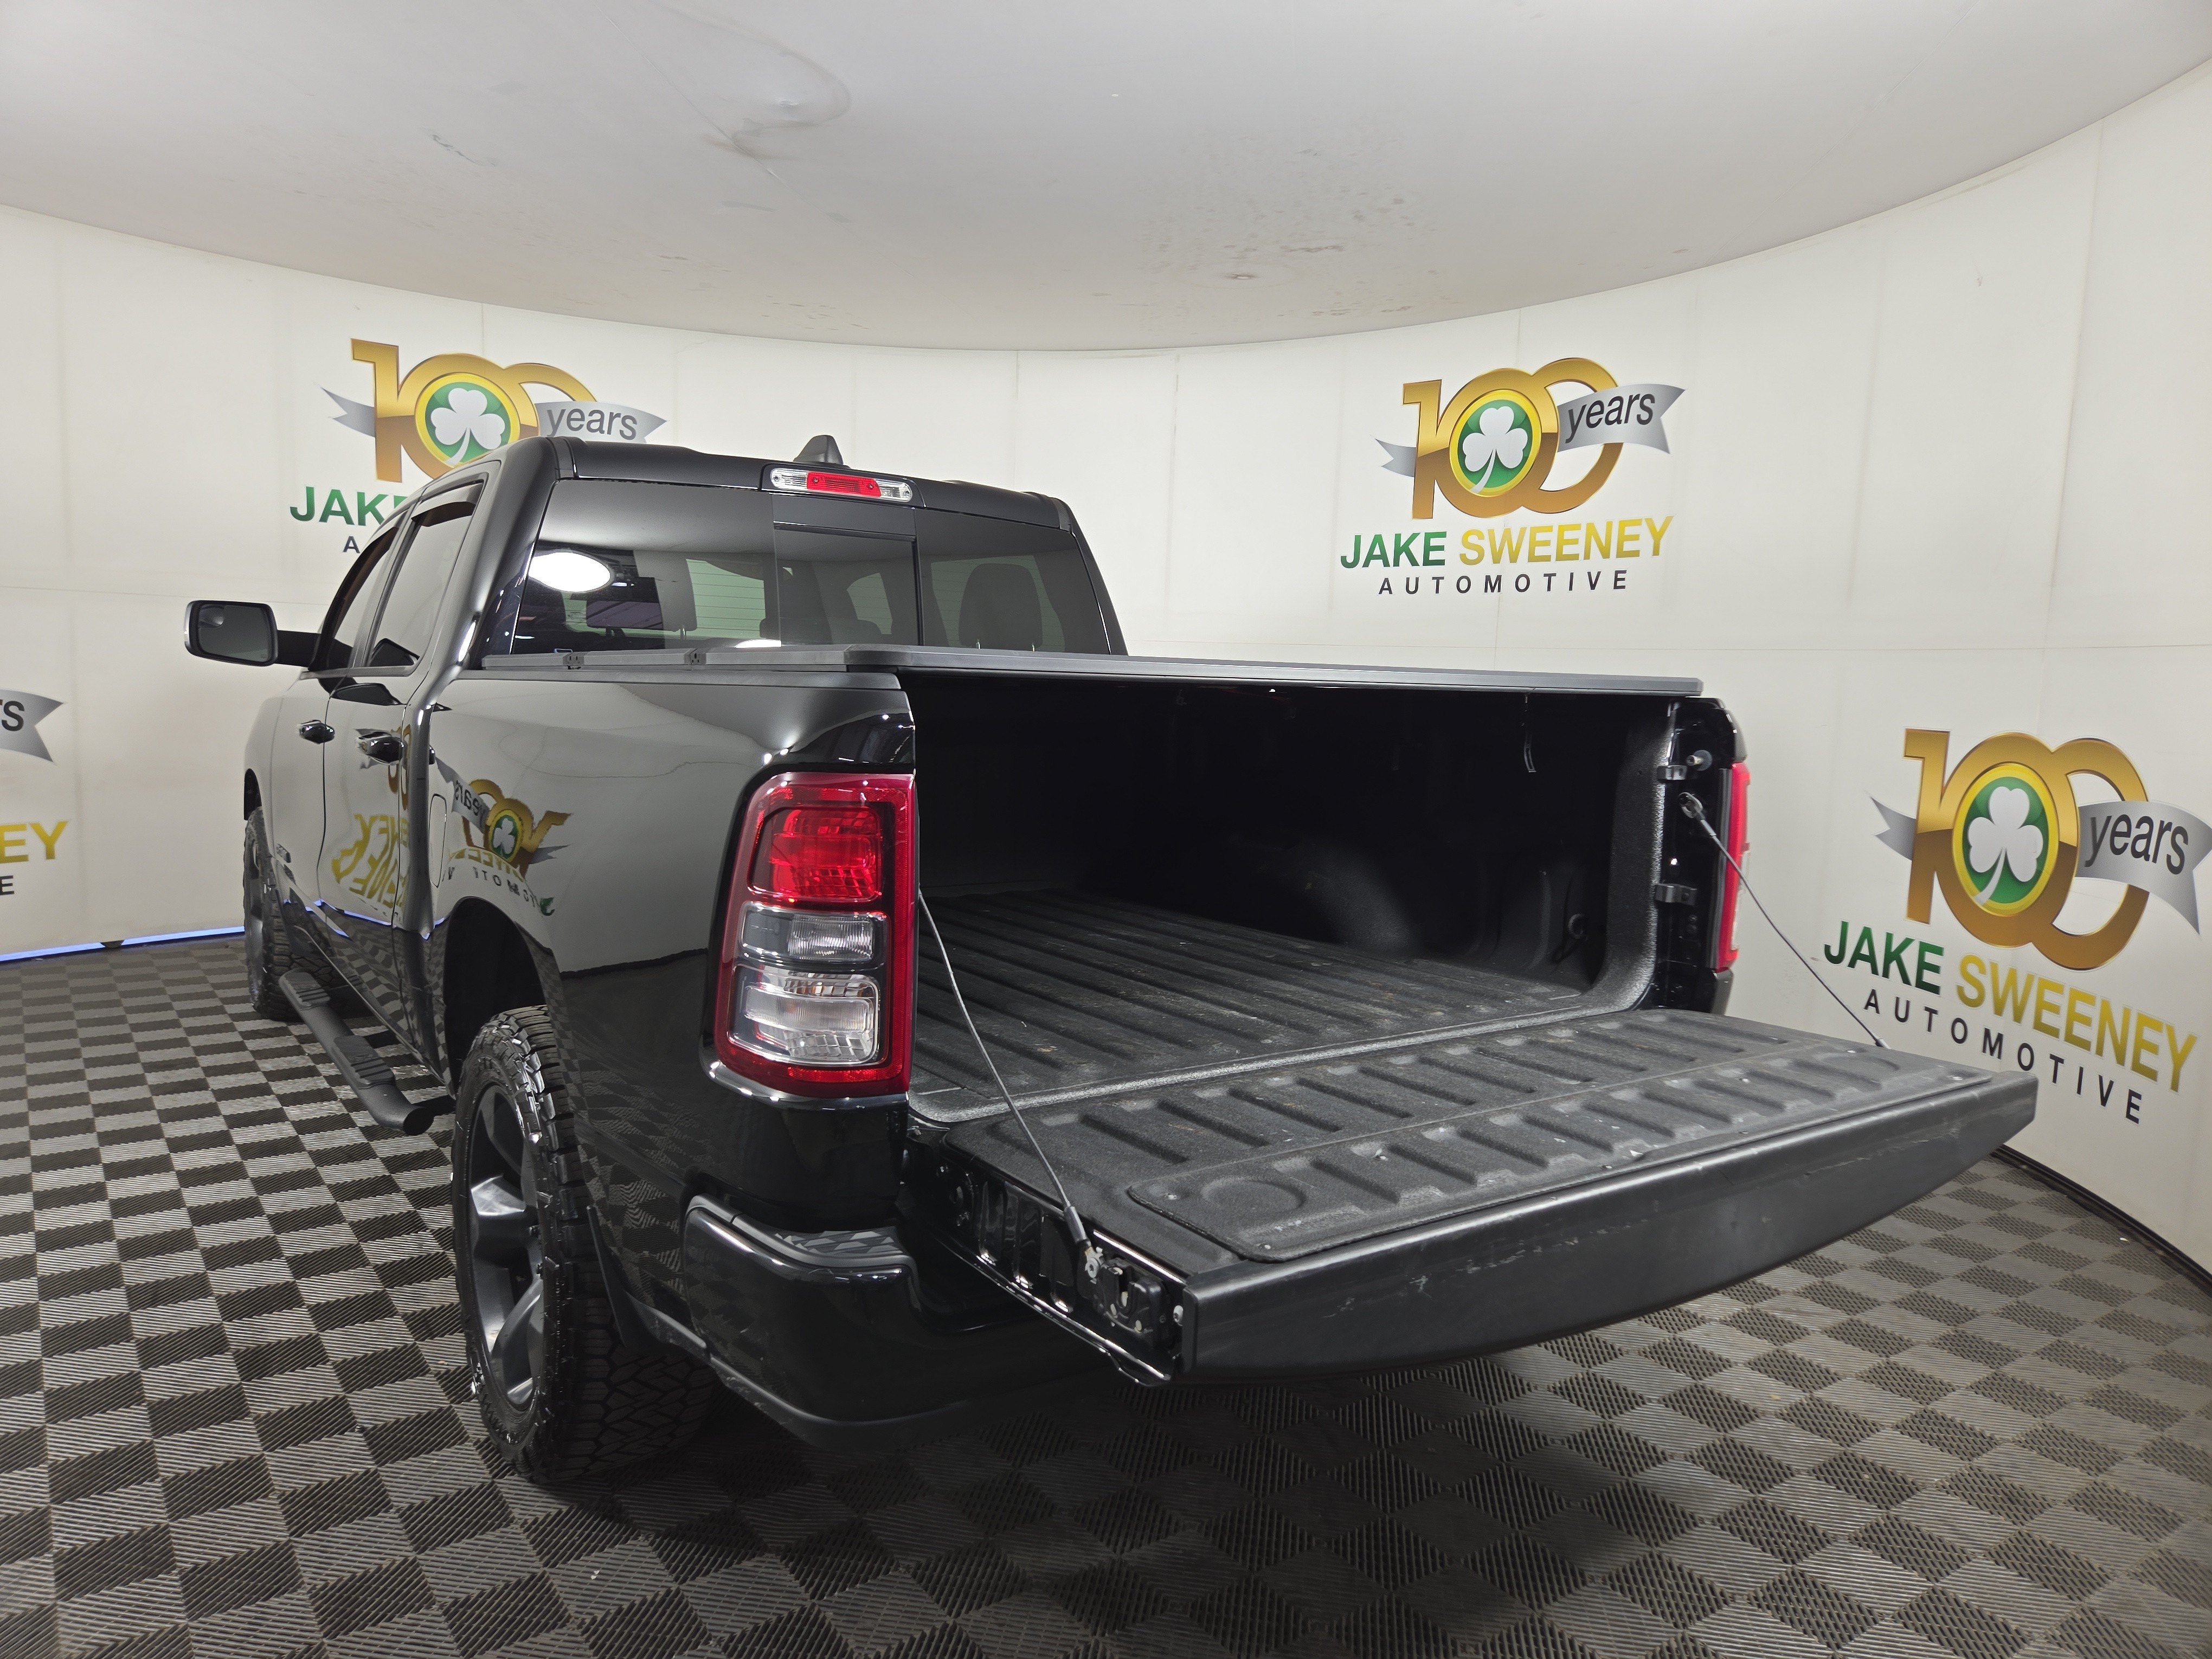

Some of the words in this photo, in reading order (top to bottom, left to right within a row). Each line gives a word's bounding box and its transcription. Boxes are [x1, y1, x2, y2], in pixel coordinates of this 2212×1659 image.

[547, 408, 637, 440] years
[1403, 357, 1624, 519] 100
[1565, 393, 1655, 443] years
[290, 486, 408, 526] JAK
[1341, 531, 1447, 569] JAKE
[1459, 516, 1674, 566] SWEENEY
[1379, 570, 1627, 595] AUTOMOTIVE
[1904, 728, 2150, 970] 100
[2085, 814, 2189, 875] years
[1824, 921, 1944, 995] JAKE
[1957, 954, 2197, 1092] SWEENEY
[1864, 989, 2142, 1124] AUTOMOTIVE
